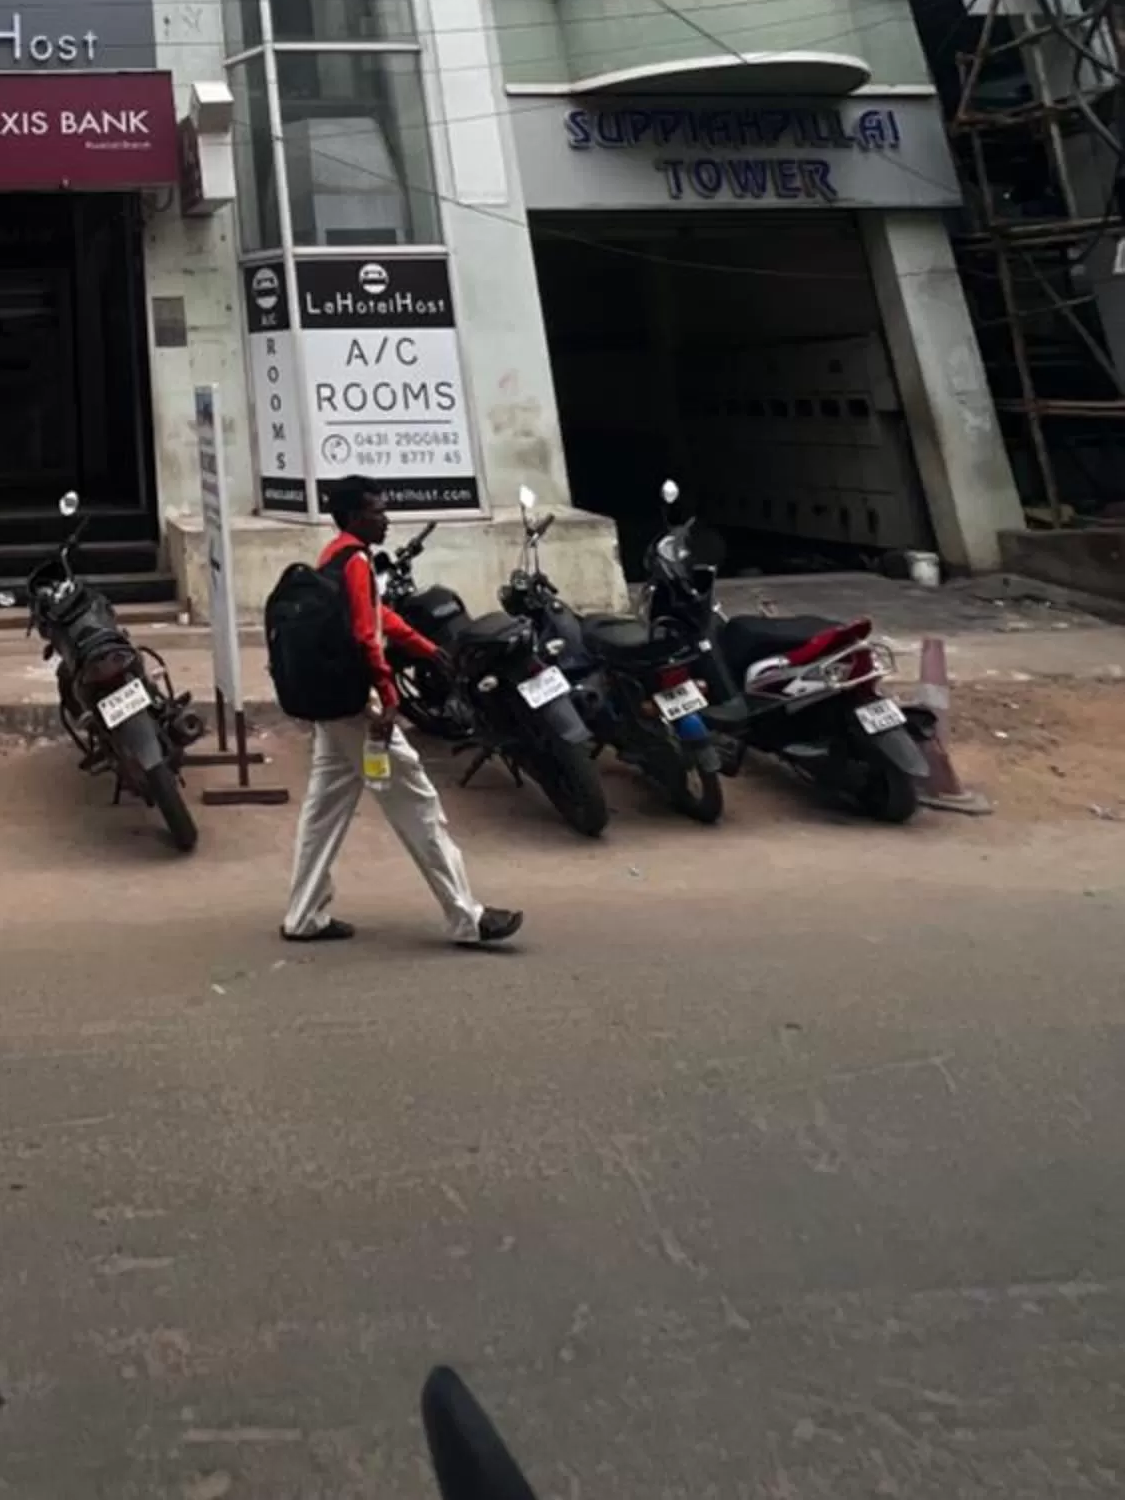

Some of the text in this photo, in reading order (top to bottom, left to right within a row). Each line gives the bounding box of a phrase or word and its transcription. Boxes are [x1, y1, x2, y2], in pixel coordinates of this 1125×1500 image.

[60, 110, 150, 134] BANK
[657, 157, 838, 203] TOWER
[306, 291, 446, 315] LeHotelHost
[346, 336, 419, 367] A/C
[316, 381, 457, 413] ROOMS
